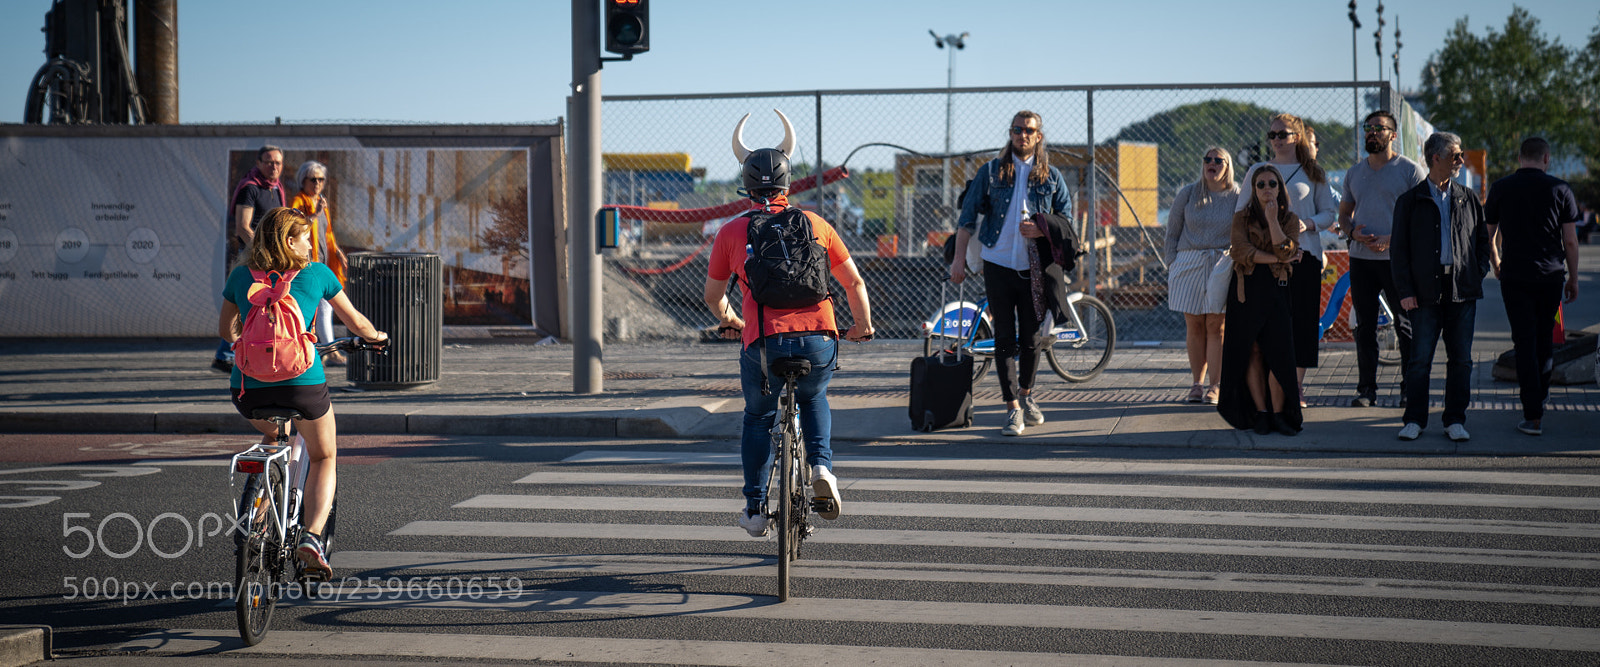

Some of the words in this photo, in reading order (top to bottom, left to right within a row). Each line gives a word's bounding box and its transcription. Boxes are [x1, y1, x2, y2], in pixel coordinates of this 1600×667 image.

[91, 202, 136, 213] Innvendige
[95, 213, 130, 222] arbeider
[62, 240, 82, 250] 2019
[132, 240, 154, 250] 2020
[31, 270, 46, 279] Tett
[47, 270, 69, 282] bugg
[83, 270, 139, 281] Ferdigstillelse
[153, 268, 181, 281] Åpning
